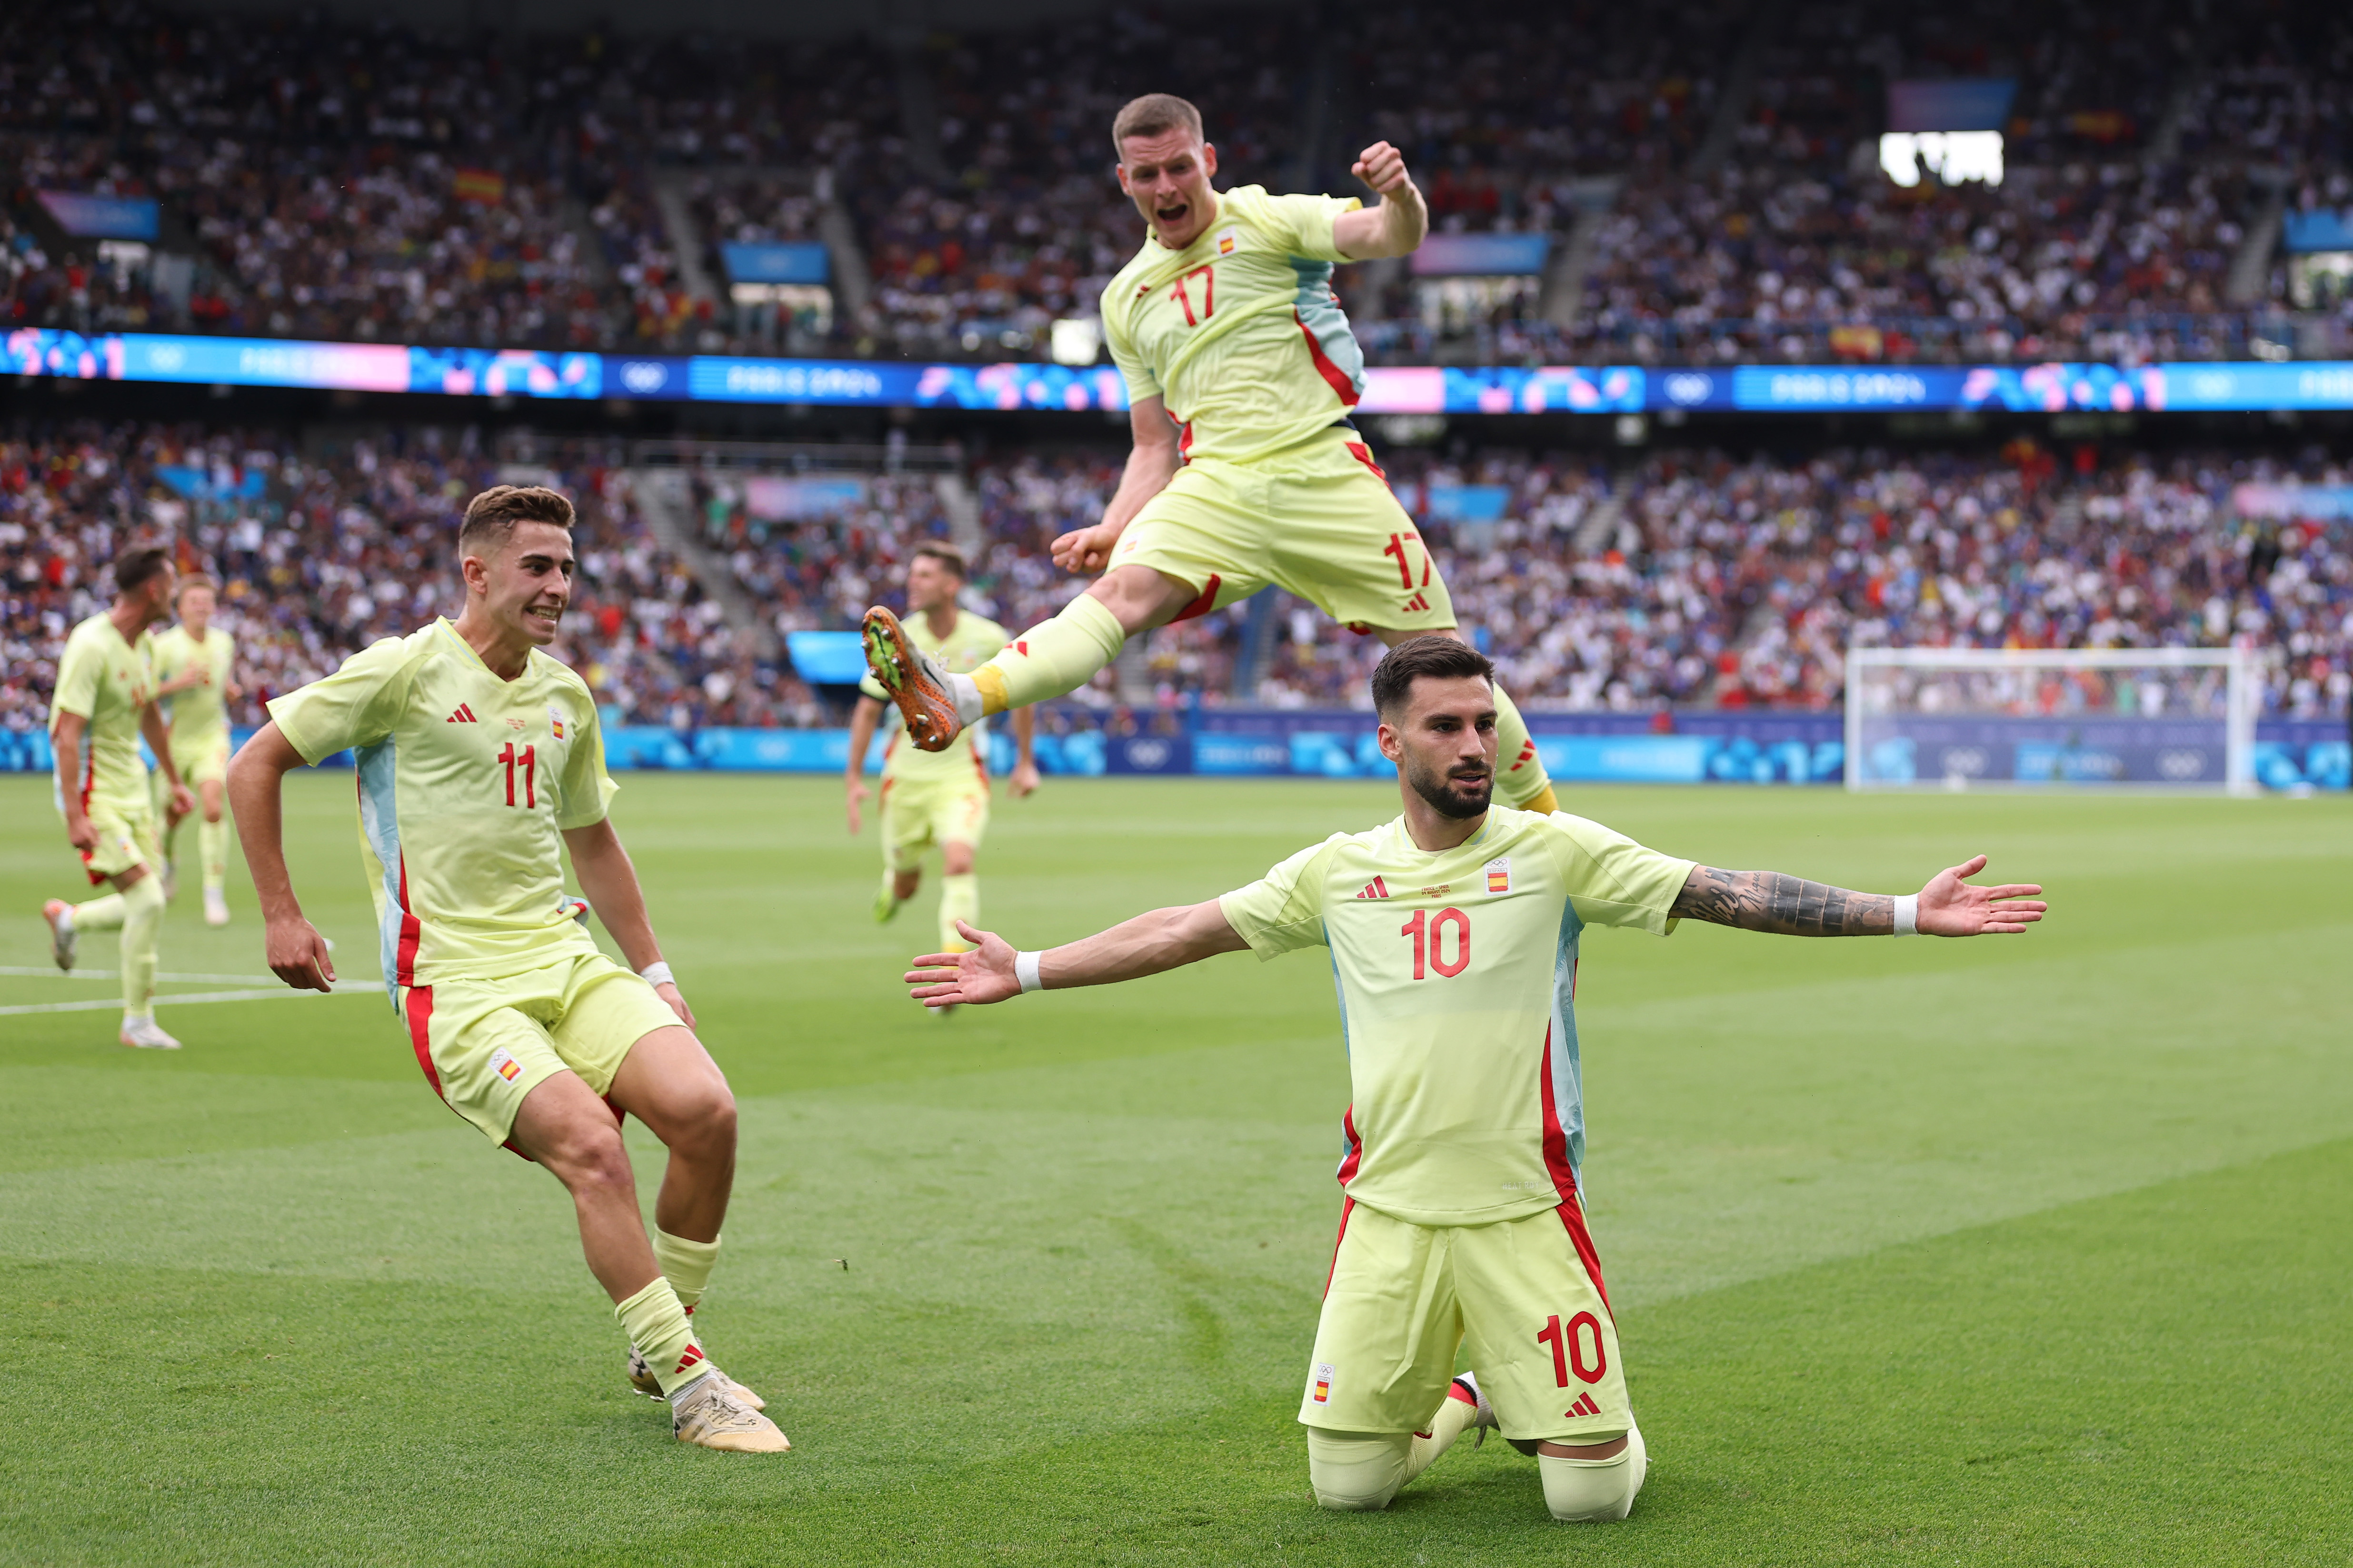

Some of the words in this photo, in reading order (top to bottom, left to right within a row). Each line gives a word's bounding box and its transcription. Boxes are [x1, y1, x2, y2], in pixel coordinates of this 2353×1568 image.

[1169, 265, 1213, 327] 17
[1384, 533, 1430, 589] 17
[498, 742, 535, 809] 11
[1402, 907, 1470, 980] 10
[1537, 1311, 1606, 1388] 10
